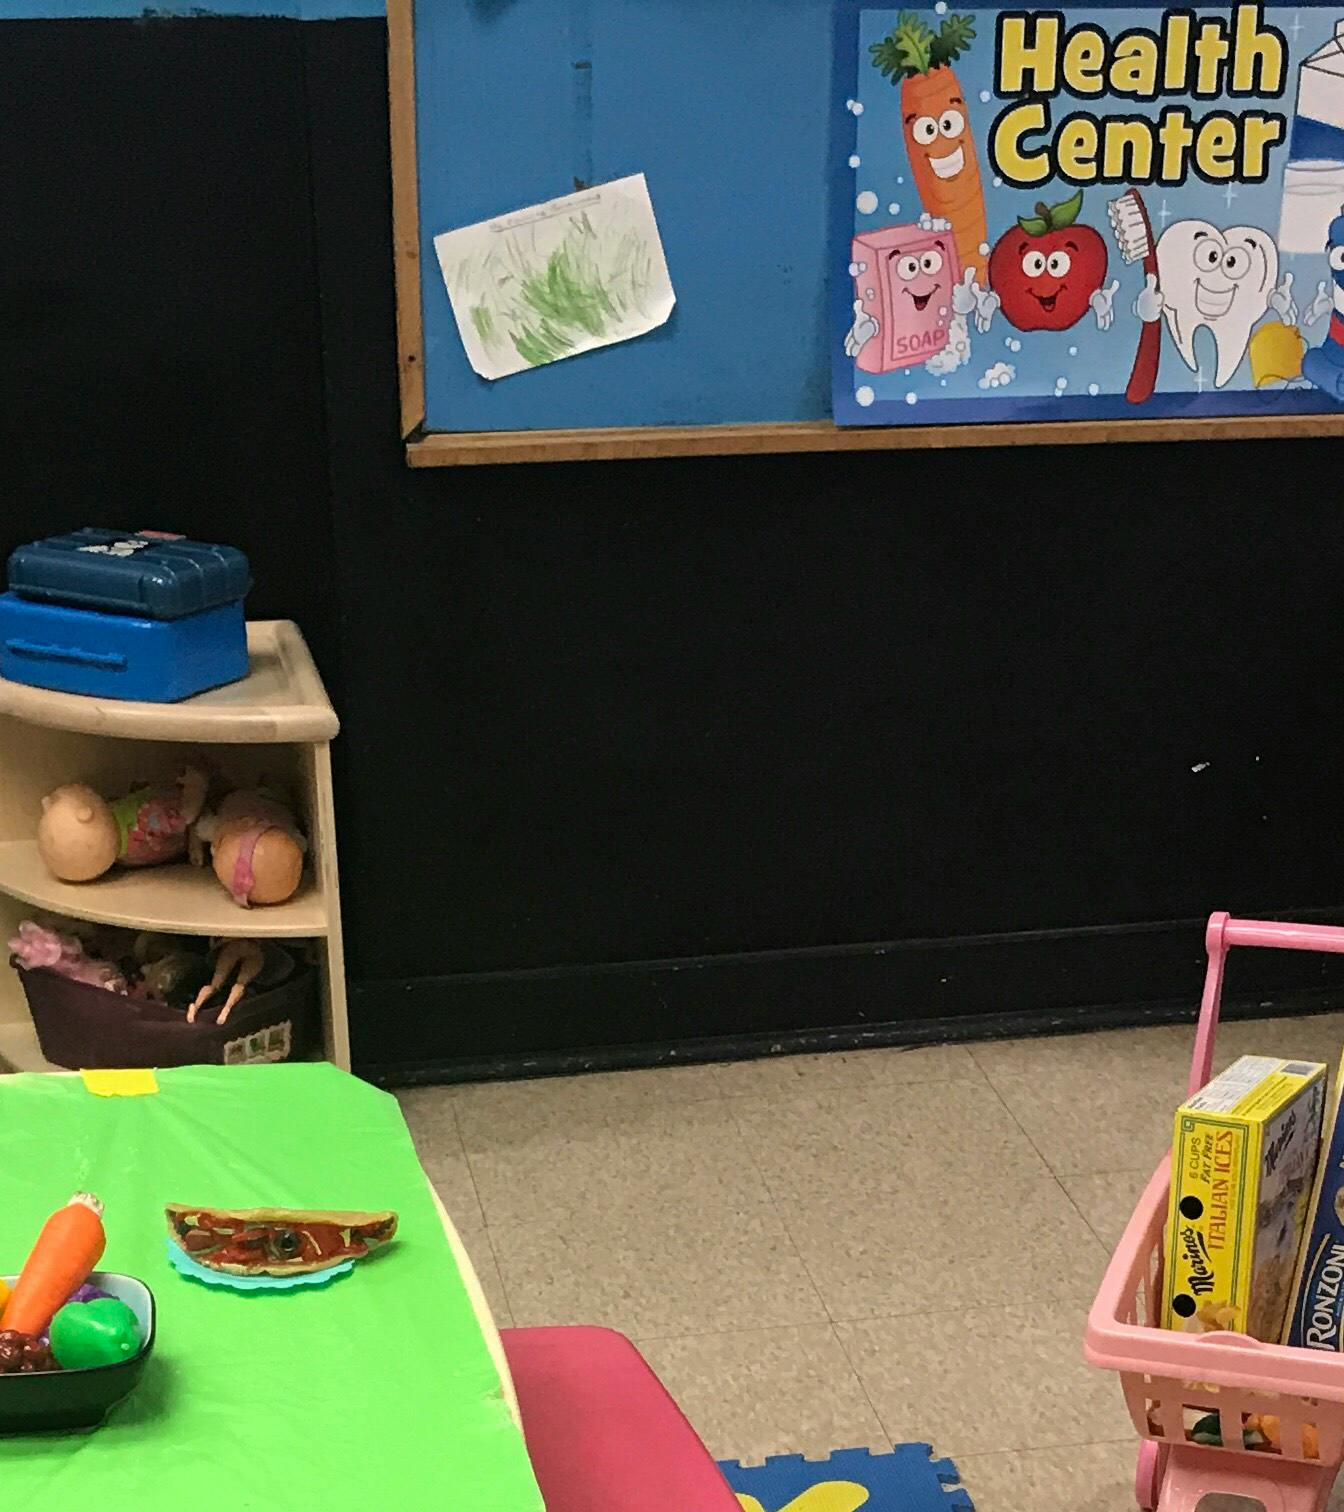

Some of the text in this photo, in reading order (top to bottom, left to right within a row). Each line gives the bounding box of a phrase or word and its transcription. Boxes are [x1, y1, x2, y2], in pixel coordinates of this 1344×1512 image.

[995, 2, 1287, 100] Health
[990, 102, 1285, 186] Center
[896, 329, 946, 354] SOAP
[1189, 1136, 1202, 1180] 6 CUPS
[1200, 1133, 1215, 1184] FAT FREE
[1208, 1130, 1234, 1250] ITALIAN ICES
